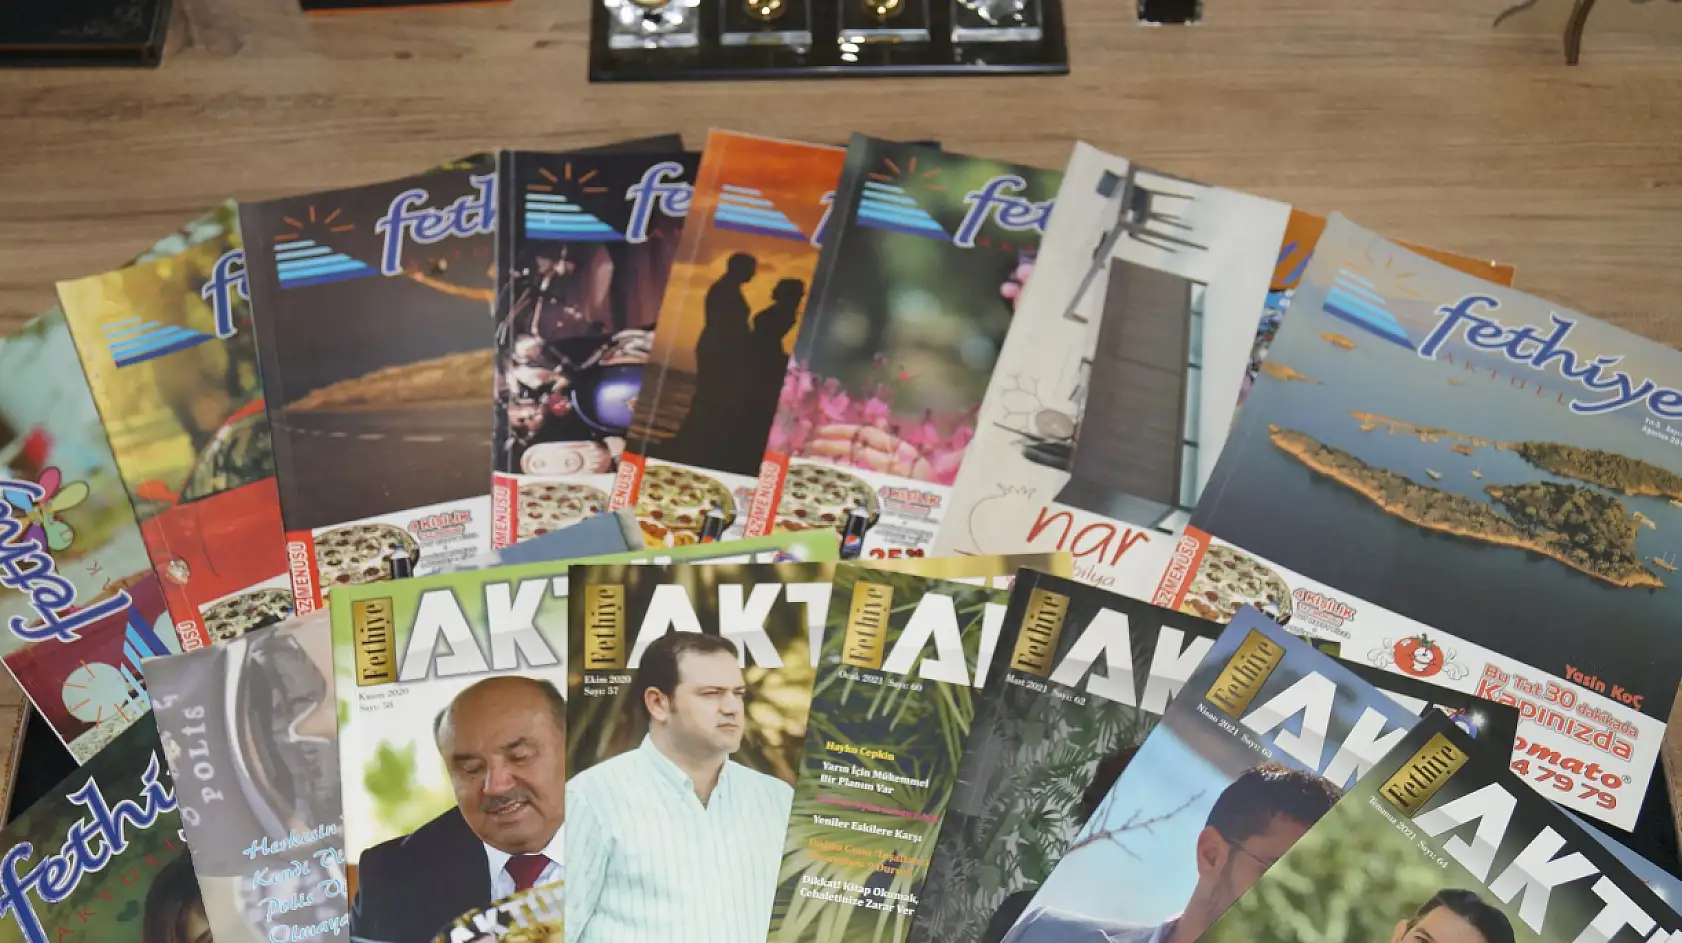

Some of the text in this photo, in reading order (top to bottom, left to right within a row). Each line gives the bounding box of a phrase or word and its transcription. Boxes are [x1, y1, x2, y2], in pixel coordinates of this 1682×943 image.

[1418, 295, 1682, 419] fethiye
[1026, 506, 1150, 567] nar
[361, 602, 391, 681] Fethiye
[398, 575, 568, 682] AK
[591, 588, 622, 665] Fethiye
[849, 586, 889, 662] Fethiye
[1017, 595, 1062, 669] Fethiye
[584, 675, 632, 685] Ekim 2020
[607, 686, 619, 696] 57
[861, 673, 884, 686] 2021
[1005, 673, 1048, 694] Mart 2021
[1212, 640, 1274, 709] Fethiye
[1483, 663, 1511, 687] Bu
[1511, 673, 1543, 697] Tat
[1544, 679, 1577, 711] 30
[1217, 716, 1240, 737] 2021
[859, 747, 895, 761] Cepkin
[820, 774, 837, 785] Bir
[875, 782, 895, 795] Var
[872, 768, 930, 789] Mükemmel
[1387, 741, 1458, 808] Fethiye
[1512, 757, 1618, 810] 4 79 79
[812, 814, 851, 830] Yeniler
[851, 821, 893, 837] Eskilere
[1395, 818, 1418, 841] 2021
[1410, 780, 1682, 943] AKT
[843, 880, 872, 897] Kitap
[865, 897, 895, 913] Zarar
